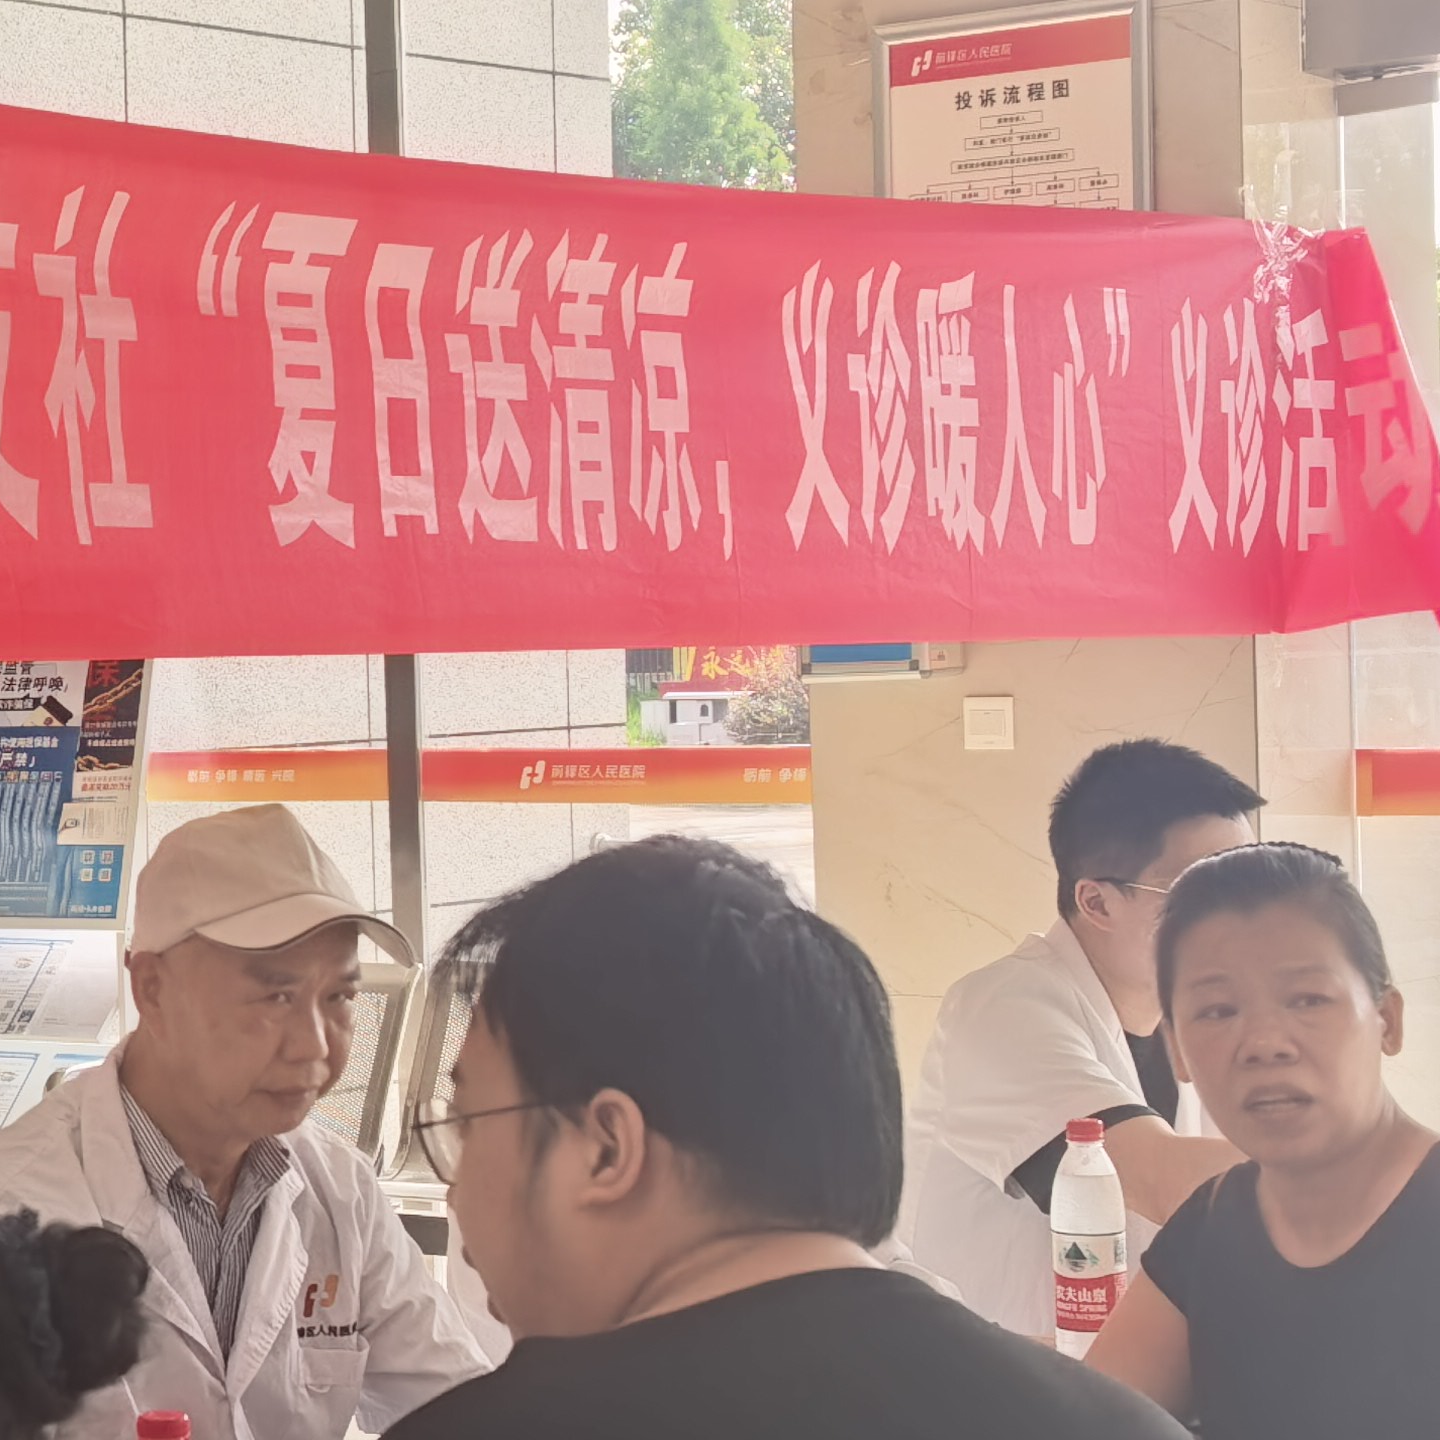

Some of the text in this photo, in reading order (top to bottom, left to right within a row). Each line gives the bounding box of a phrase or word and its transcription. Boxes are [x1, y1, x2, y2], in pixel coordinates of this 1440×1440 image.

[954, 78, 1070, 110] 投诉流程图
